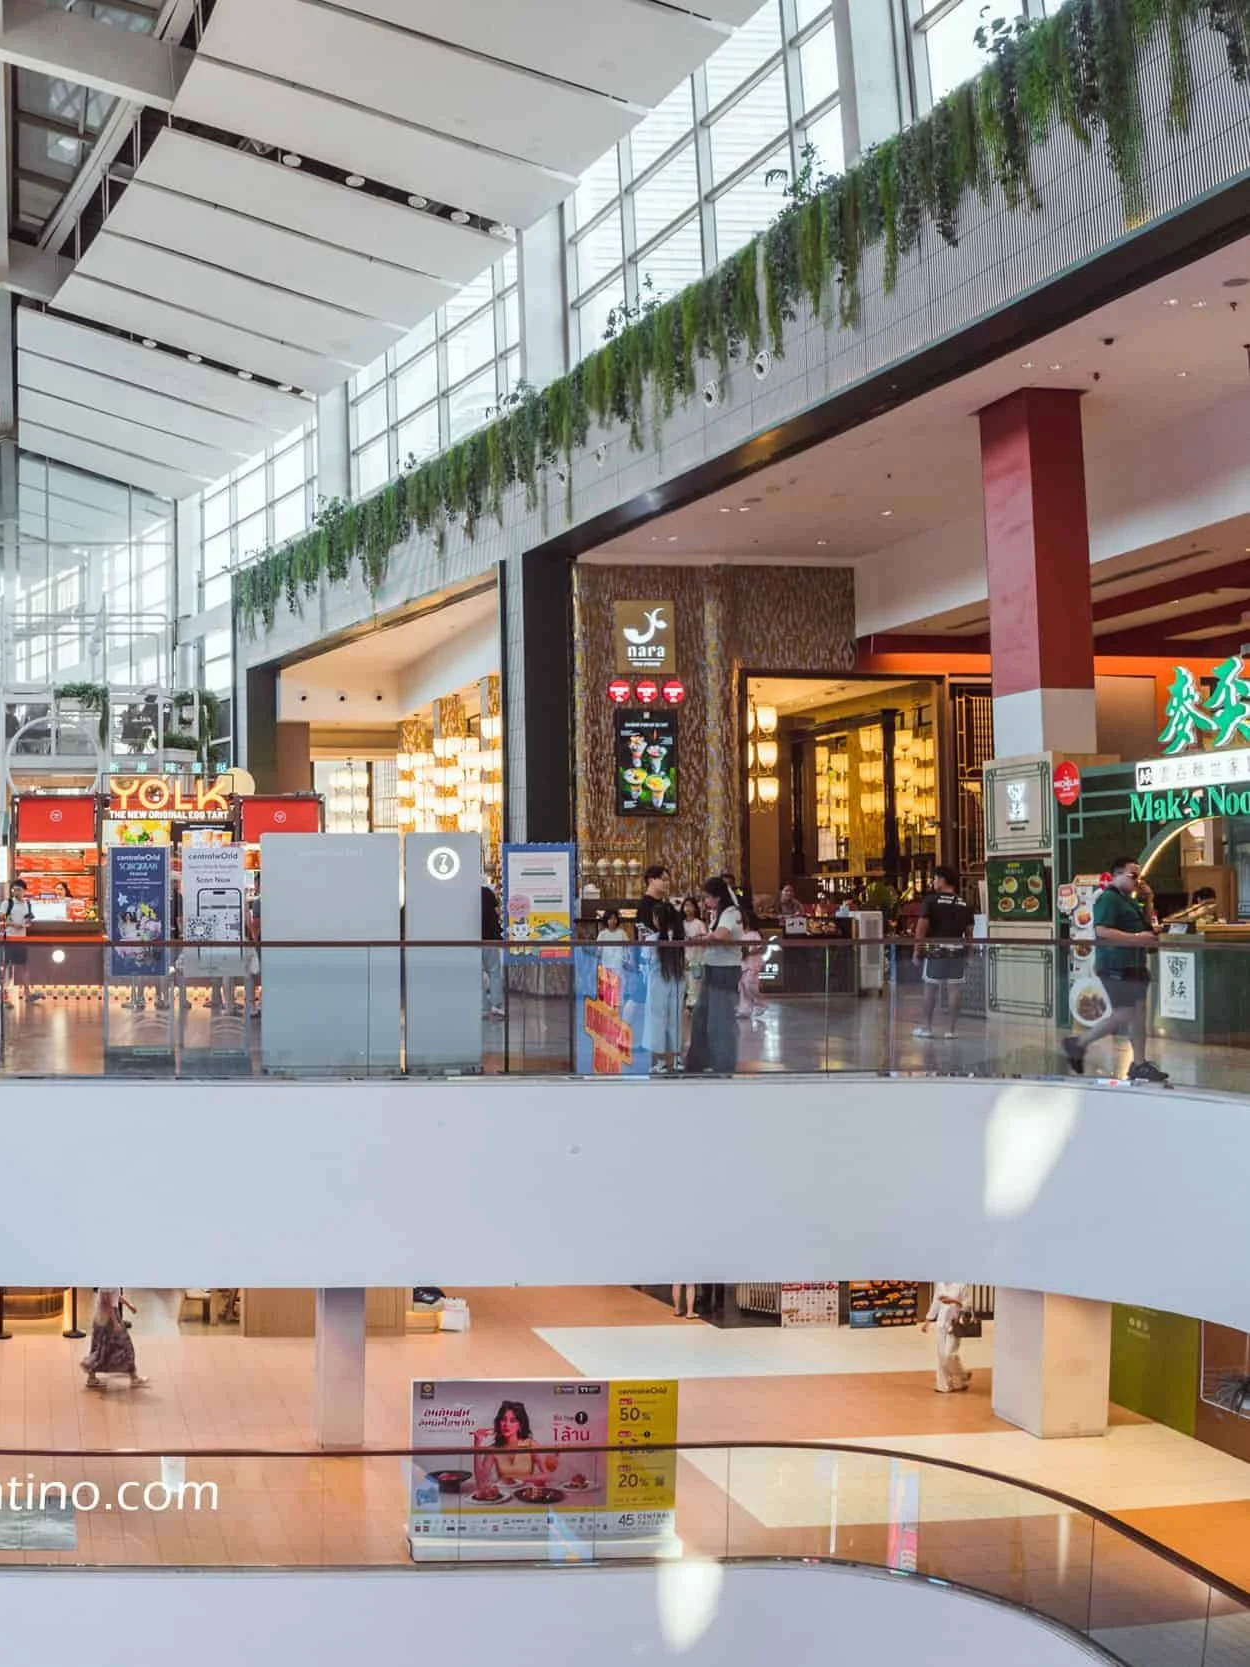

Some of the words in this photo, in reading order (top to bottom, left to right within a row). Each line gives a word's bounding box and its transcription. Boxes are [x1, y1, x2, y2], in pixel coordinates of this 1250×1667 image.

[627, 645, 666, 658] nara
[1128, 787, 1201, 825] Mak's
[110, 811, 126, 819] THE
[127, 811, 148, 820] NEW
[148, 811, 188, 820] ORIGINAL
[206, 811, 228, 820] TART
